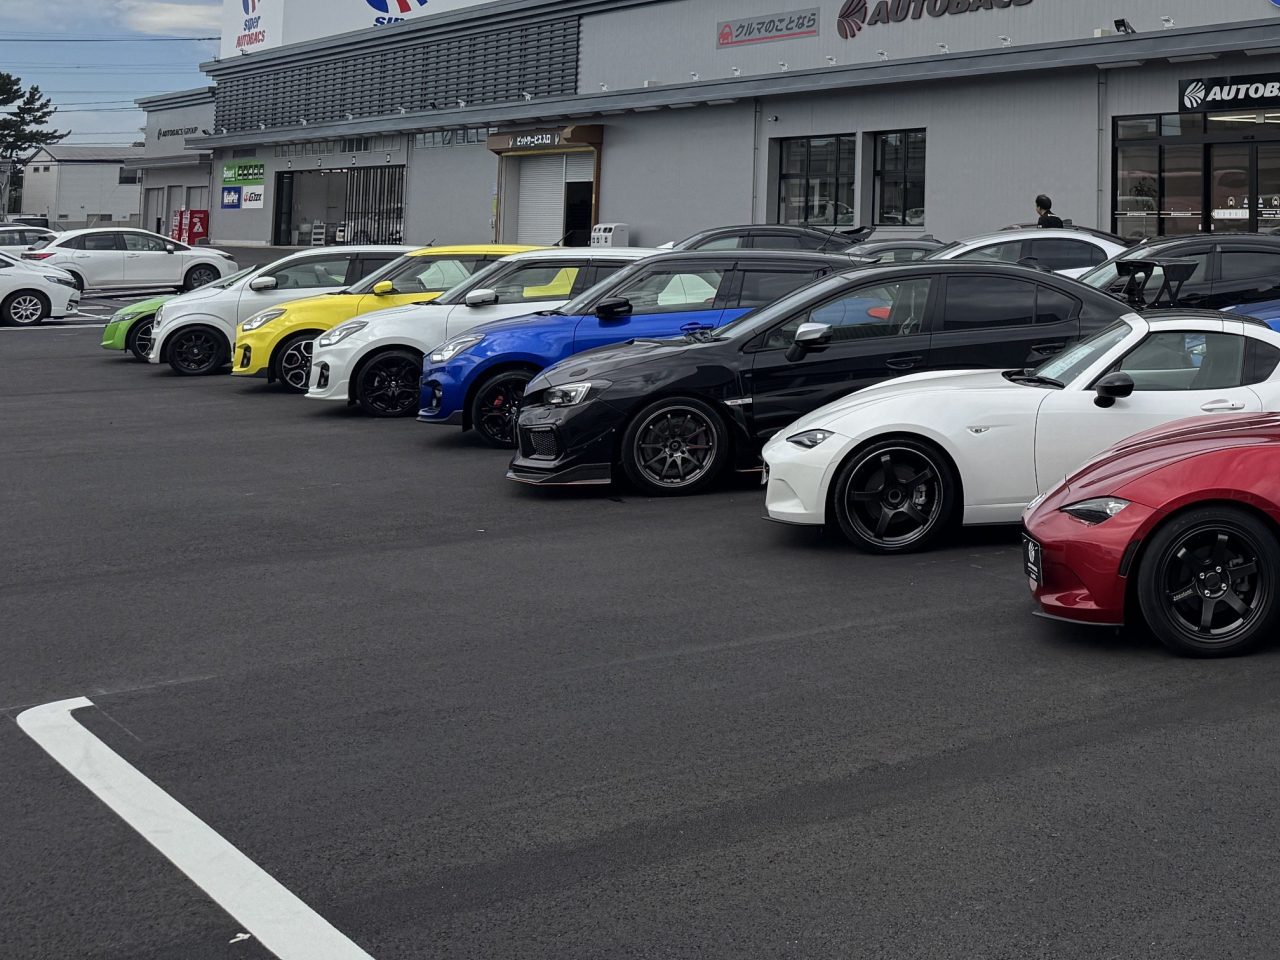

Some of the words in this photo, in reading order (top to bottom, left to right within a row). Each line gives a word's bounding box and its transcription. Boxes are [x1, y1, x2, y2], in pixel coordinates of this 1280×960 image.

[734, 12, 817, 38] クルマのことなら
[236, 30, 266, 48] AUTOBACS
[162, 128, 183, 137] AUTOBACS
[516, 134, 551, 146] ピットサービス入口
